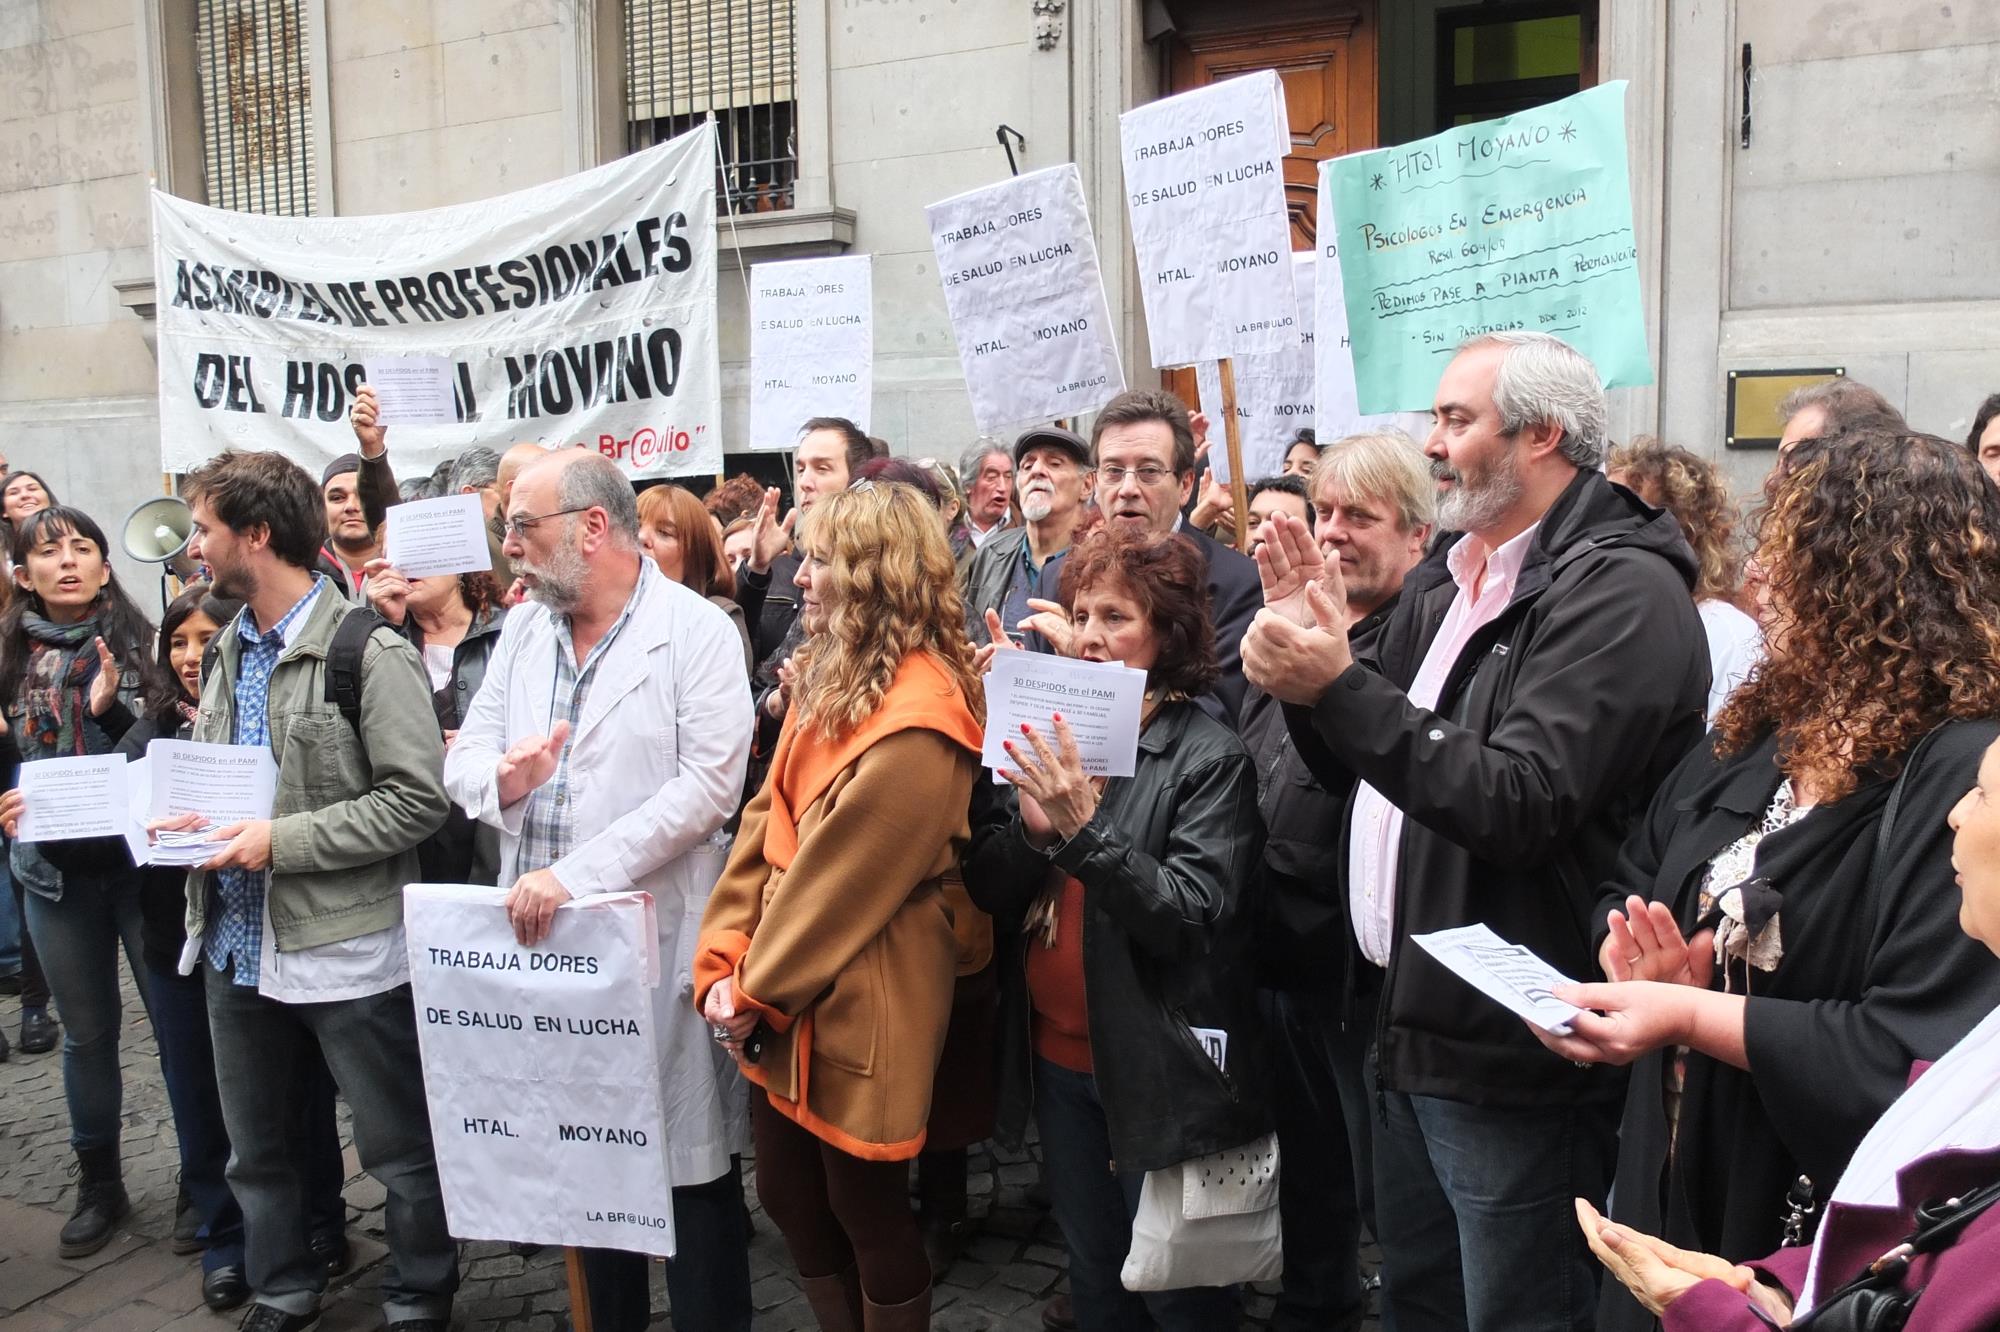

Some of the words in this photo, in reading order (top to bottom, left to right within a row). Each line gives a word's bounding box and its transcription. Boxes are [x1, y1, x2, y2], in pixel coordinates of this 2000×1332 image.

[1134, 135, 1194, 161] TRABAJA
[1458, 125, 1551, 161] MOYANO
[1131, 192, 1149, 208] DE
[1151, 180, 1197, 202] SALUD
[1204, 173, 1223, 189] EN
[1227, 160, 1275, 184] LUCHA
[941, 220, 996, 246] TRABAJA
[171, 258, 343, 326] ASAMBLEA
[327, 280, 389, 327] DE
[375, 211, 692, 324] PROFESIONALES
[945, 272, 959, 287] DE
[961, 261, 1004, 282] SALUD
[1009, 256, 1027, 270] EN
[1029, 243, 1073, 265] LUCHA
[1157, 268, 1196, 284] HTAL.
[1217, 250, 1279, 275] MOYANO
[760, 287, 806, 298] TRABAJA
[1432, 286, 1462, 301] PASE
[1476, 282, 1485, 295] A
[769, 319, 804, 329] SALUD
[825, 315, 862, 326] LUCHA
[1235, 323, 1248, 333] LA
[1249, 316, 1293, 332] BR@ULIO
[1566, 306, 1588, 319] 2012
[974, 338, 1010, 356] HTAL.
[1032, 317, 1088, 344] MOYANO
[194, 352, 267, 413] DEL
[503, 327, 683, 420] MOYANO
[764, 379, 792, 389] HTAL.
[811, 373, 857, 385] MOYANO
[1056, 383, 1067, 394] LA
[1220, 406, 1253, 418] HAL.
[1013, 676, 1024, 687] 30
[1025, 679, 1067, 693] DESPIDOS
[1068, 687, 1079, 695] en
[1081, 687, 1089, 696] el
[1091, 689, 1116, 700] PAMI
[428, 947, 521, 972] TRABAJA
[529, 952, 599, 975] DORES
[426, 1006, 452, 1026] DE
[457, 1010, 523, 1031] SALUD
[535, 1015, 562, 1033] EN
[567, 1017, 641, 1037] LUCHA
[463, 1117, 520, 1139] HTAL.
[558, 1123, 648, 1148] MOYANO
[586, 1210, 604, 1222] LA
[607, 1211, 667, 1230] BR@ULIO
